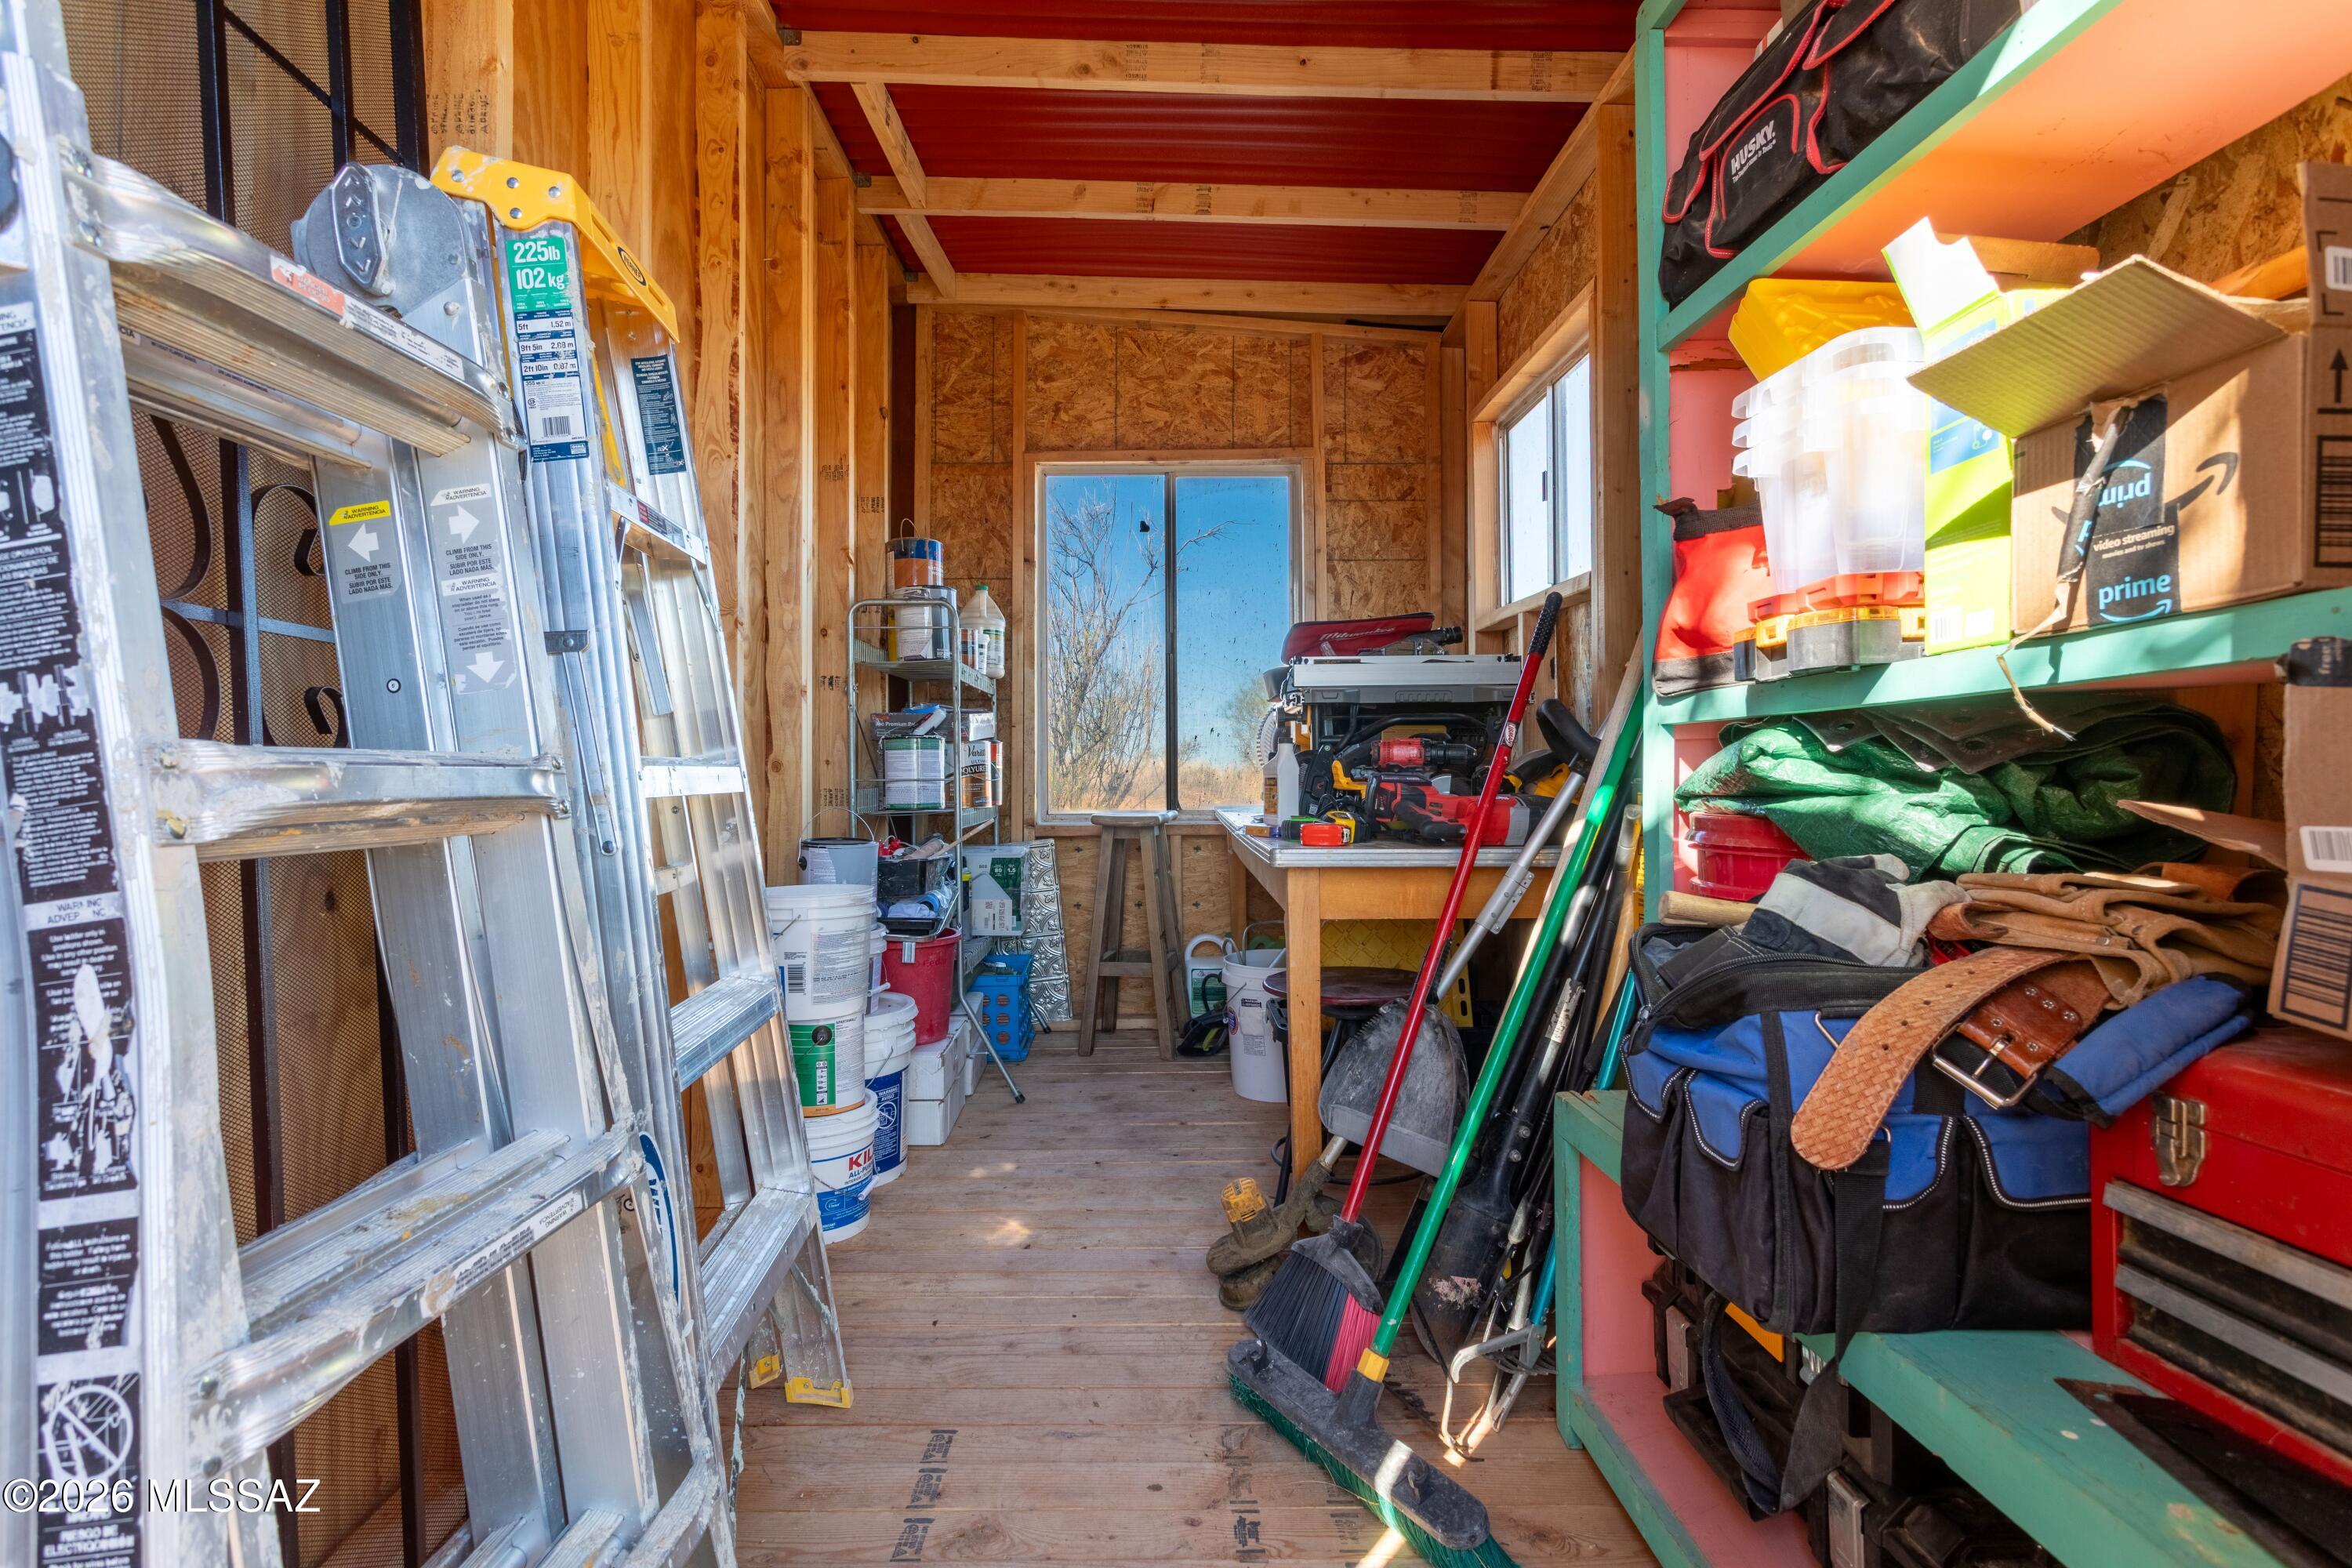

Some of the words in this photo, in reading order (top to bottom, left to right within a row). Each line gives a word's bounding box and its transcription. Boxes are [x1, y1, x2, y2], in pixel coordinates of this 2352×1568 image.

[514, 241, 561, 263] 225lb
[623, 254, 641, 278] WERNER
[516, 267, 546, 289] 102
[548, 273, 565, 289] kg
[449, 491, 487, 500] ADVERTENCIA
[453, 487, 481, 495] WARNING
[2099, 474, 2151, 508] prim
[347, 509, 386, 519] ADVERTENCIA
[2092, 536, 2122, 553] video
[2122, 524, 2176, 547] streaming
[2102, 548, 2124, 559] movies
[2124, 546, 2137, 555] and
[2145, 540, 2165, 550] shows
[344, 565, 361, 575] CLIMB
[362, 564, 379, 573] FROM
[379, 562, 391, 571] THIS
[349, 579, 365, 588] SUBIR
[365, 578, 379, 586] POR
[364, 585, 379, 593] NADA
[456, 581, 496, 592] ADVERTENCIA
[2099, 574, 2172, 610] prime
[878, 1087, 898, 1097] WARNING
